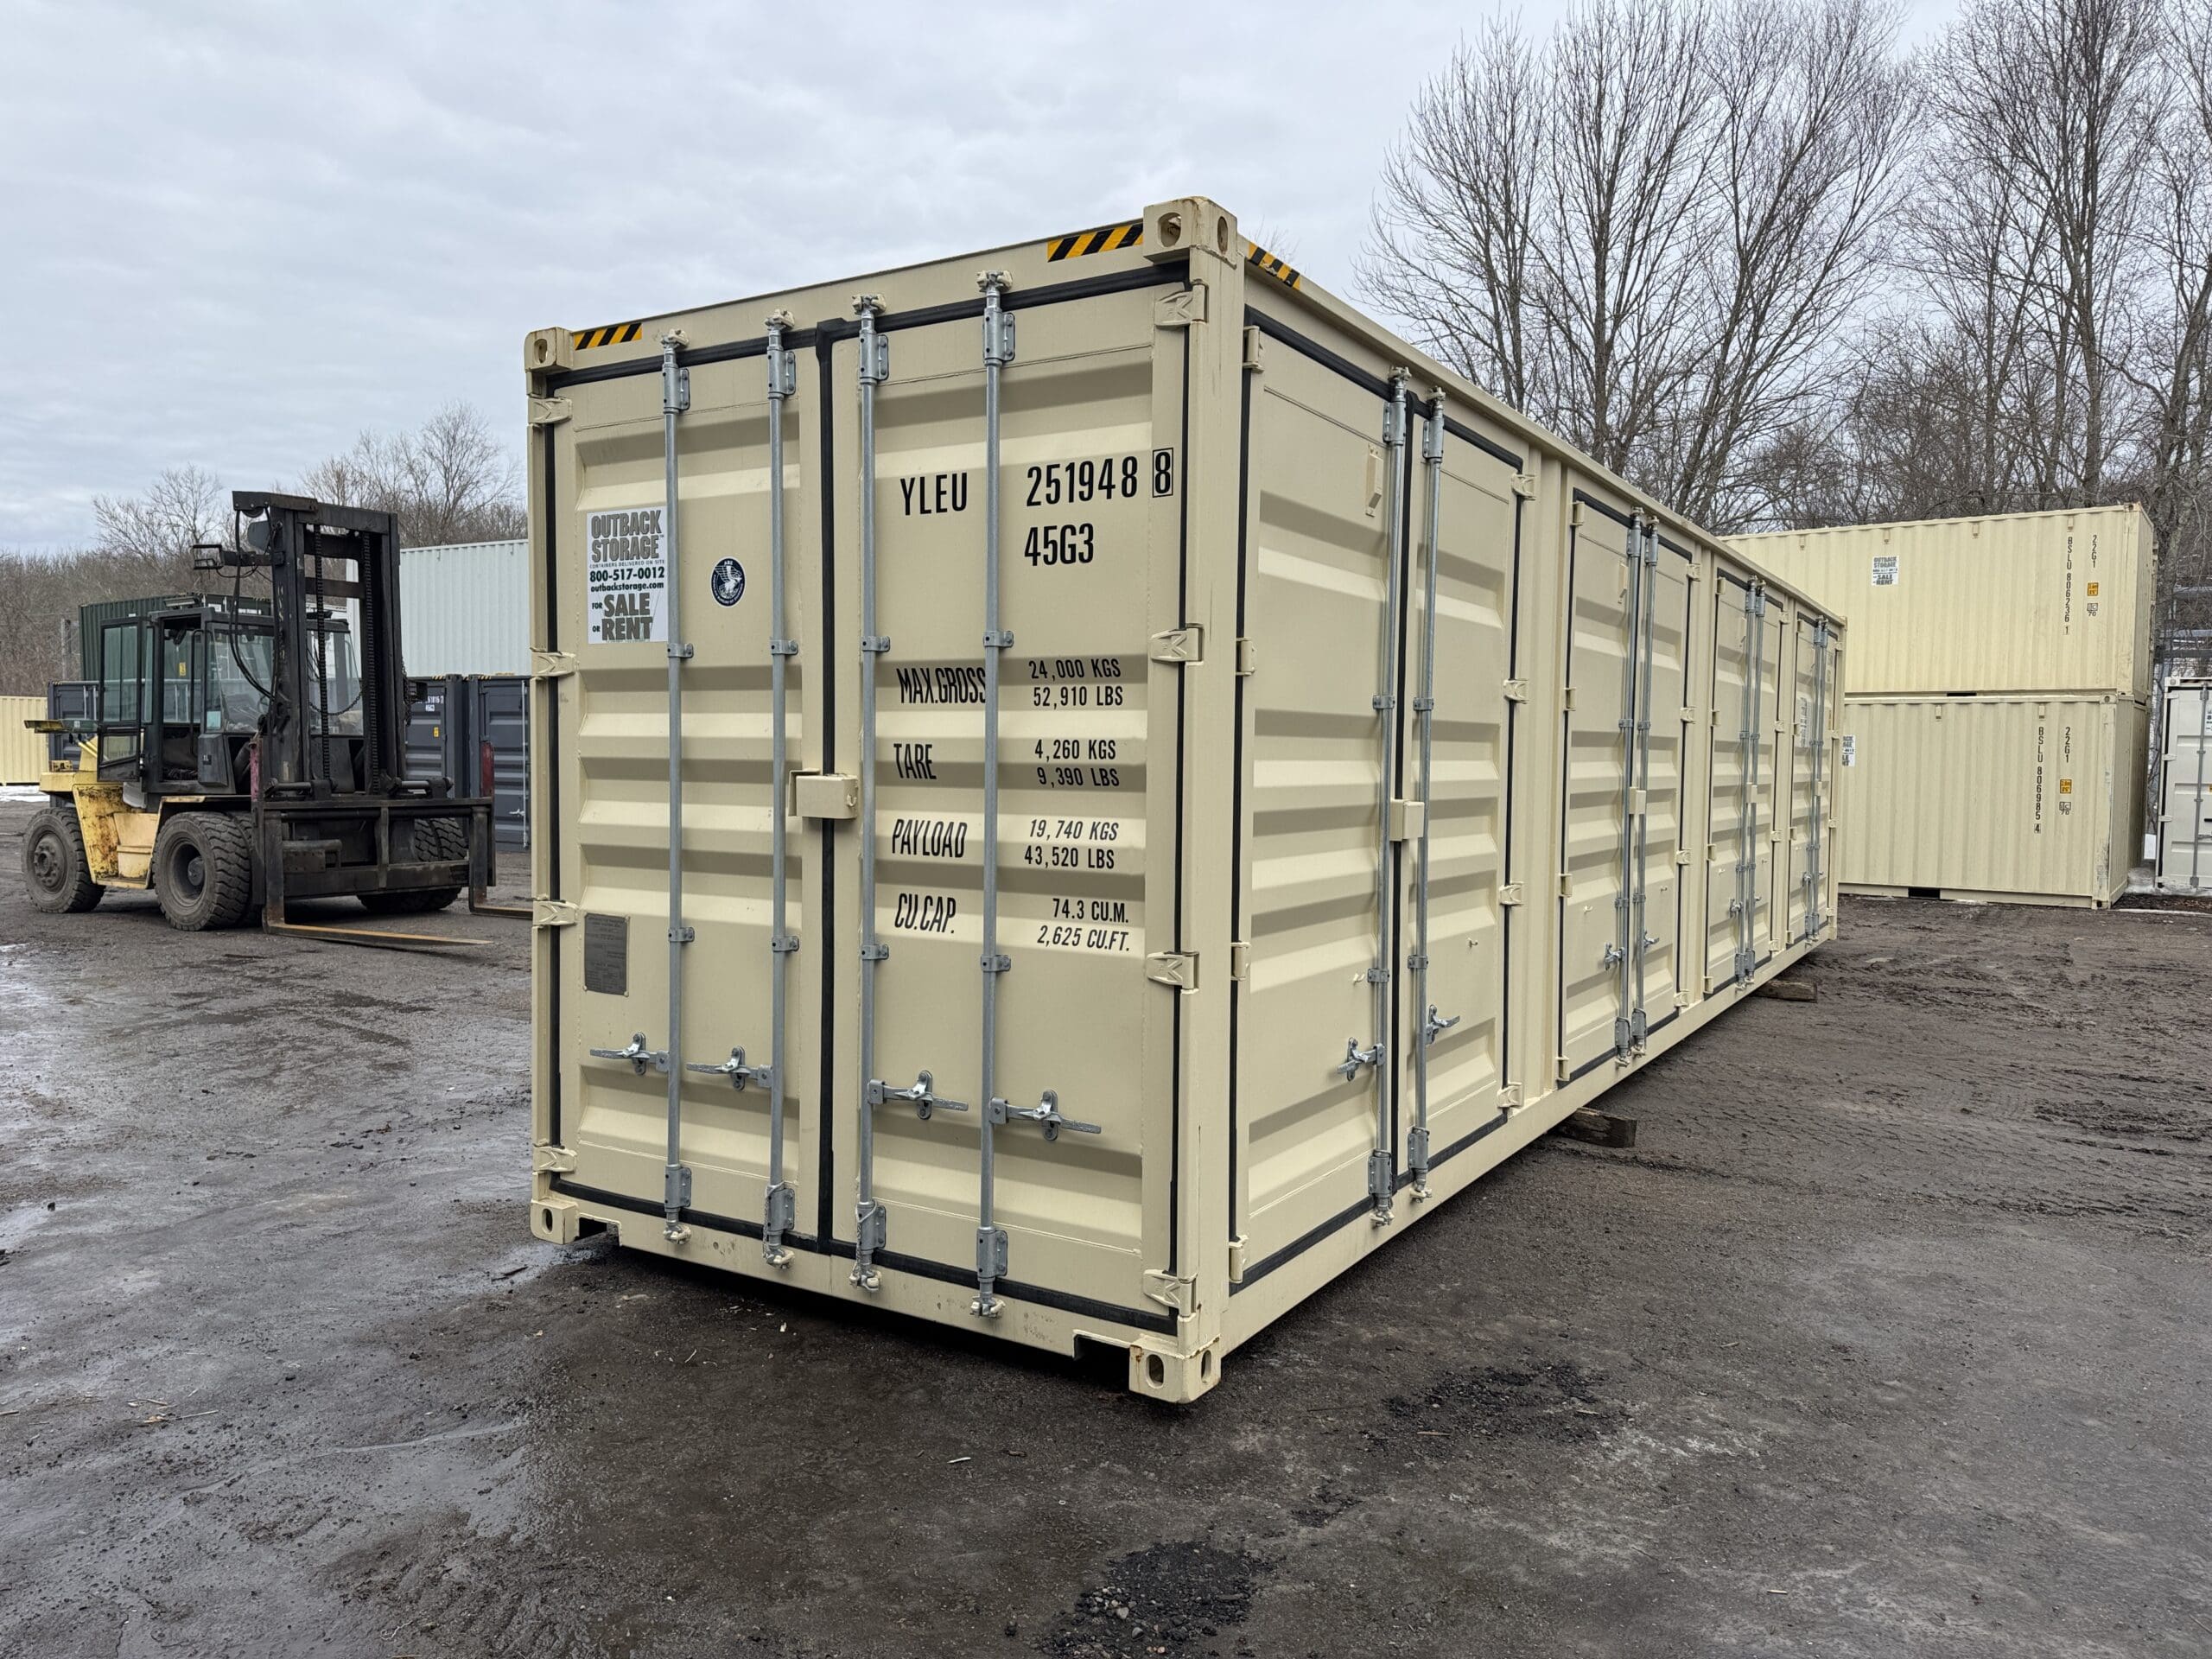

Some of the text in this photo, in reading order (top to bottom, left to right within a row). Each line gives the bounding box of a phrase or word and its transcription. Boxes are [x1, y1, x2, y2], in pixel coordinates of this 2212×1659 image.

[900, 451, 1172, 516] YLEU 251948 8
[591, 510, 662, 539] OUTBACK
[592, 535, 659, 563] STORAGE
[1024, 523, 1094, 566] 45G3
[589, 567, 664, 582] 800-517-0012
[591, 582, 664, 592] outbackstorage.com
[604, 593, 650, 617] SALE
[601, 617, 653, 640] RENT
[896, 658, 1121, 704] MAX.GROSS 24,000 KGS
[1033, 686, 1123, 709] 52,910 LBS
[893, 739, 1116, 779] TARE 4,260 KGS
[1037, 767, 1119, 788] 9,390 LBS
[892, 819, 1119, 857] PAYLOAD 19,740 KGS
[1025, 846, 1115, 869] 43,520 LBS
[894, 893, 1128, 933] CU.CAP. 74.3 CU.M.
[1037, 925, 1130, 951] 2,625 CU.FT.
